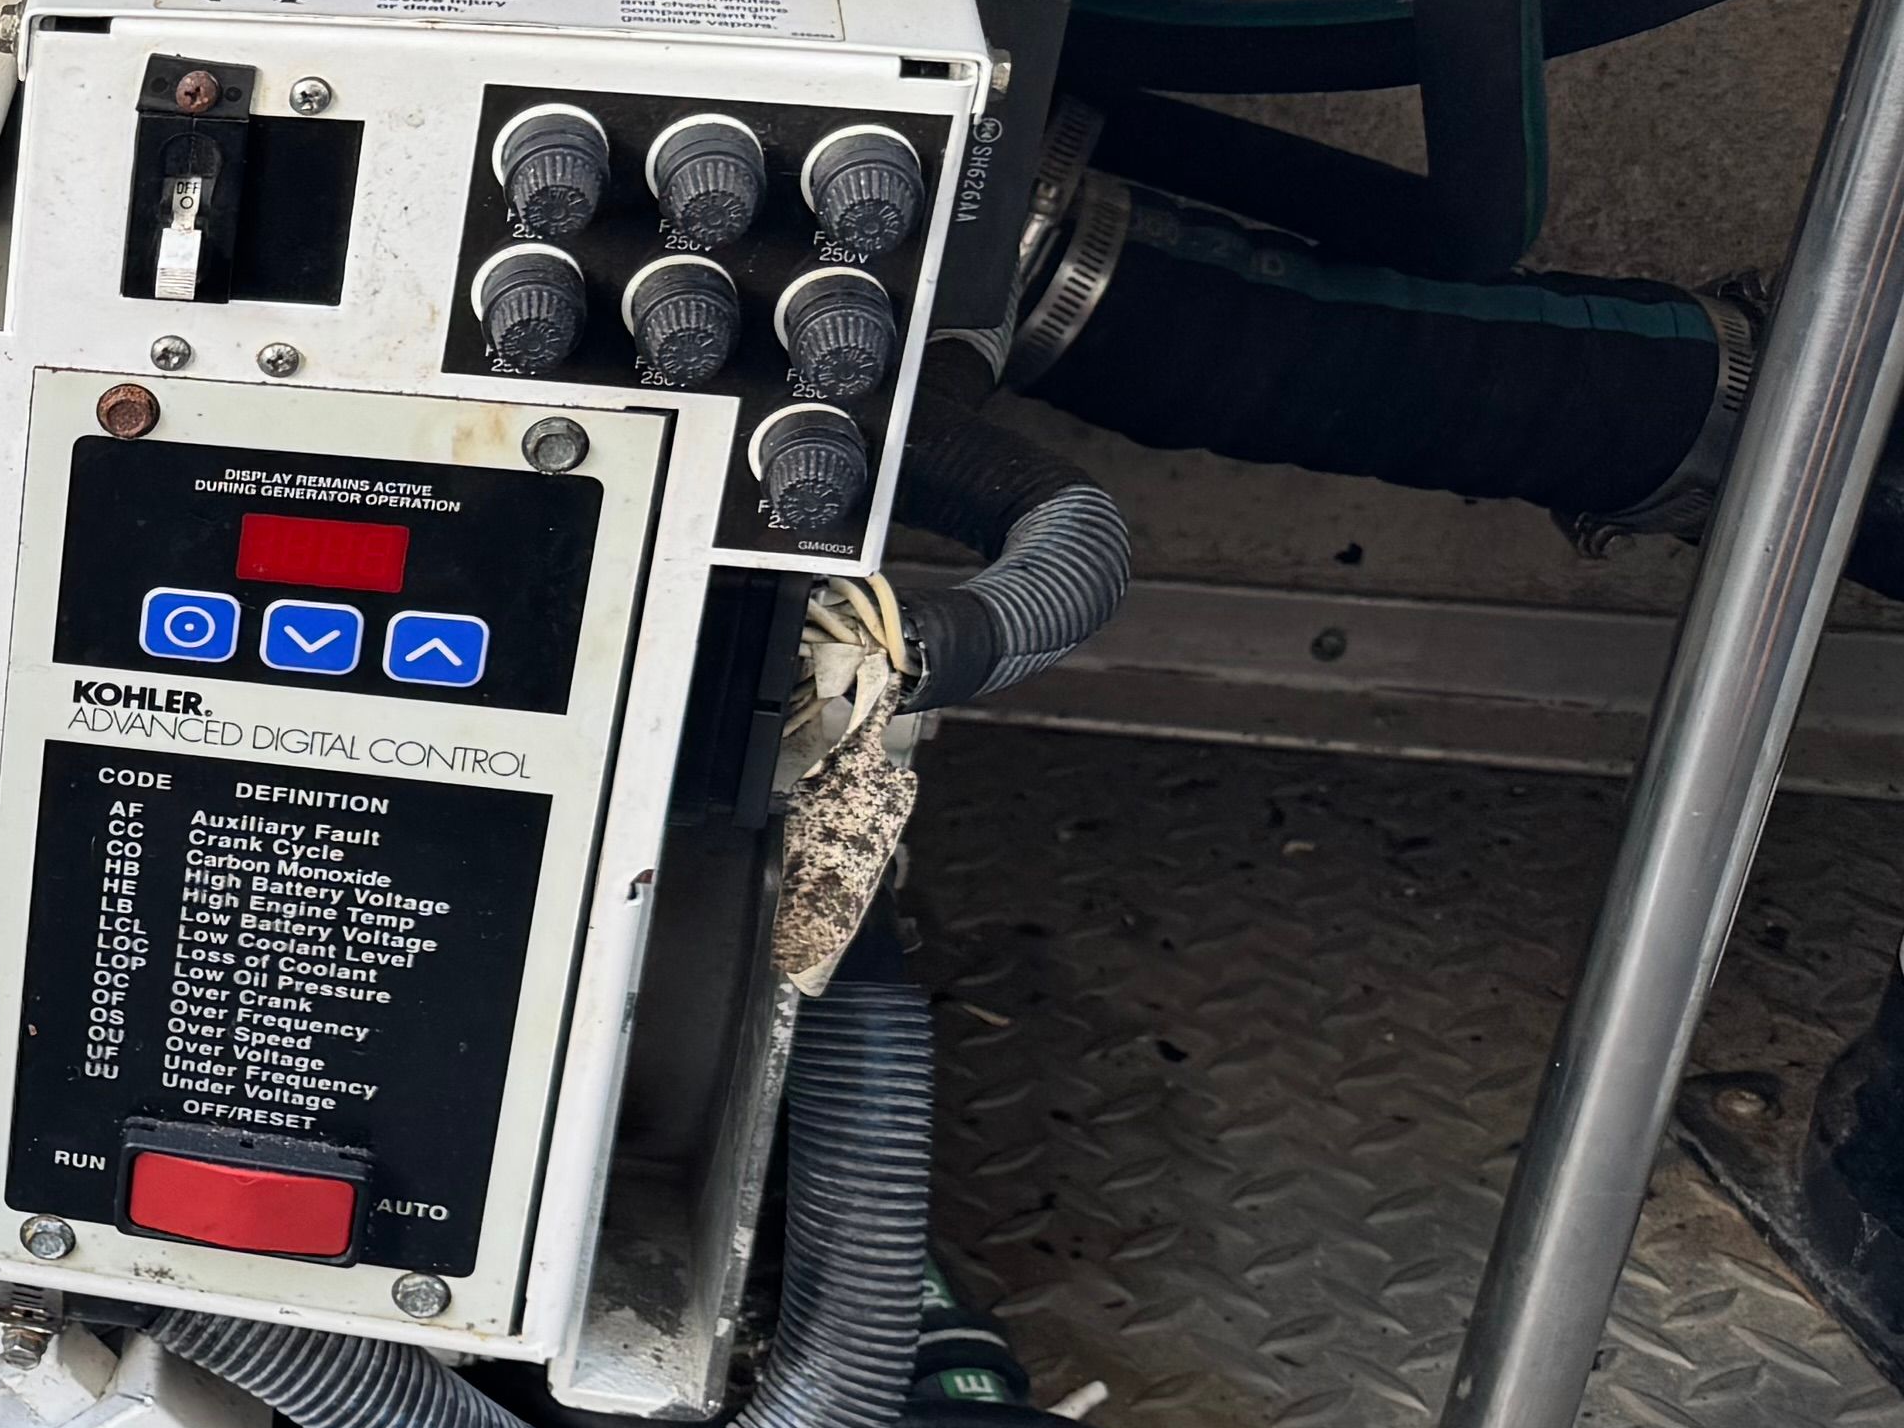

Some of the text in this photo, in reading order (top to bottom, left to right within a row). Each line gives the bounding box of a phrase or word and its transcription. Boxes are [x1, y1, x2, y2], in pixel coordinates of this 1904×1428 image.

[403, 3, 465, 13] death.
[661, 0, 718, 10] check
[723, 4, 789, 15] engine
[750, 13, 777, 21] for
[177, 182, 198, 194] OFF
[194, 479, 461, 513] DURING GENERATOR OPERATION
[224, 468, 433, 497] DISPLAY REMAINS ACTIVE
[797, 540, 855, 555] GM40035
[71, 678, 205, 716] KOHLER
[68, 704, 533, 780] ADVANCED DIGITAL CONTROL
[97, 766, 390, 815] CODE DEFINITION
[109, 800, 143, 819] AF
[107, 820, 144, 839] CC
[190, 809, 381, 847] Auxiliary Fault
[105, 839, 142, 859] CO
[188, 829, 345, 866] Crank Cycle
[103, 858, 140, 877] HB
[185, 849, 392, 888] Carbon Monoxide
[102, 877, 137, 896] HE
[183, 868, 451, 918] High Battery Voltage
[100, 896, 133, 915] LB
[181, 887, 416, 934] High Engine Temp
[98, 915, 147, 935] LCL
[180, 906, 438, 956] Low Battery Voltage
[96, 933, 150, 955] LOC
[178, 925, 415, 969] Low Coolant Level
[94, 952, 146, 973] LOP
[175, 943, 378, 984] Loss of Coolant
[93, 970, 130, 990] OC
[173, 962, 392, 1005] Low Oil Pressure
[91, 989, 125, 1008] OF
[171, 980, 313, 1013] Over Crank
[89, 1007, 124, 1026] OS
[169, 999, 369, 1043] Over Frequency
[167, 1017, 312, 1054] Over Speed
[165, 1036, 326, 1075] Over Voltage
[161, 1072, 337, 1113] Under Voltage
[163, 1054, 378, 1100] Under Frequency
[182, 1099, 317, 1132] OFF/RESET
[53, 1149, 106, 1171] RUN
[376, 1197, 449, 1222] AUTO
